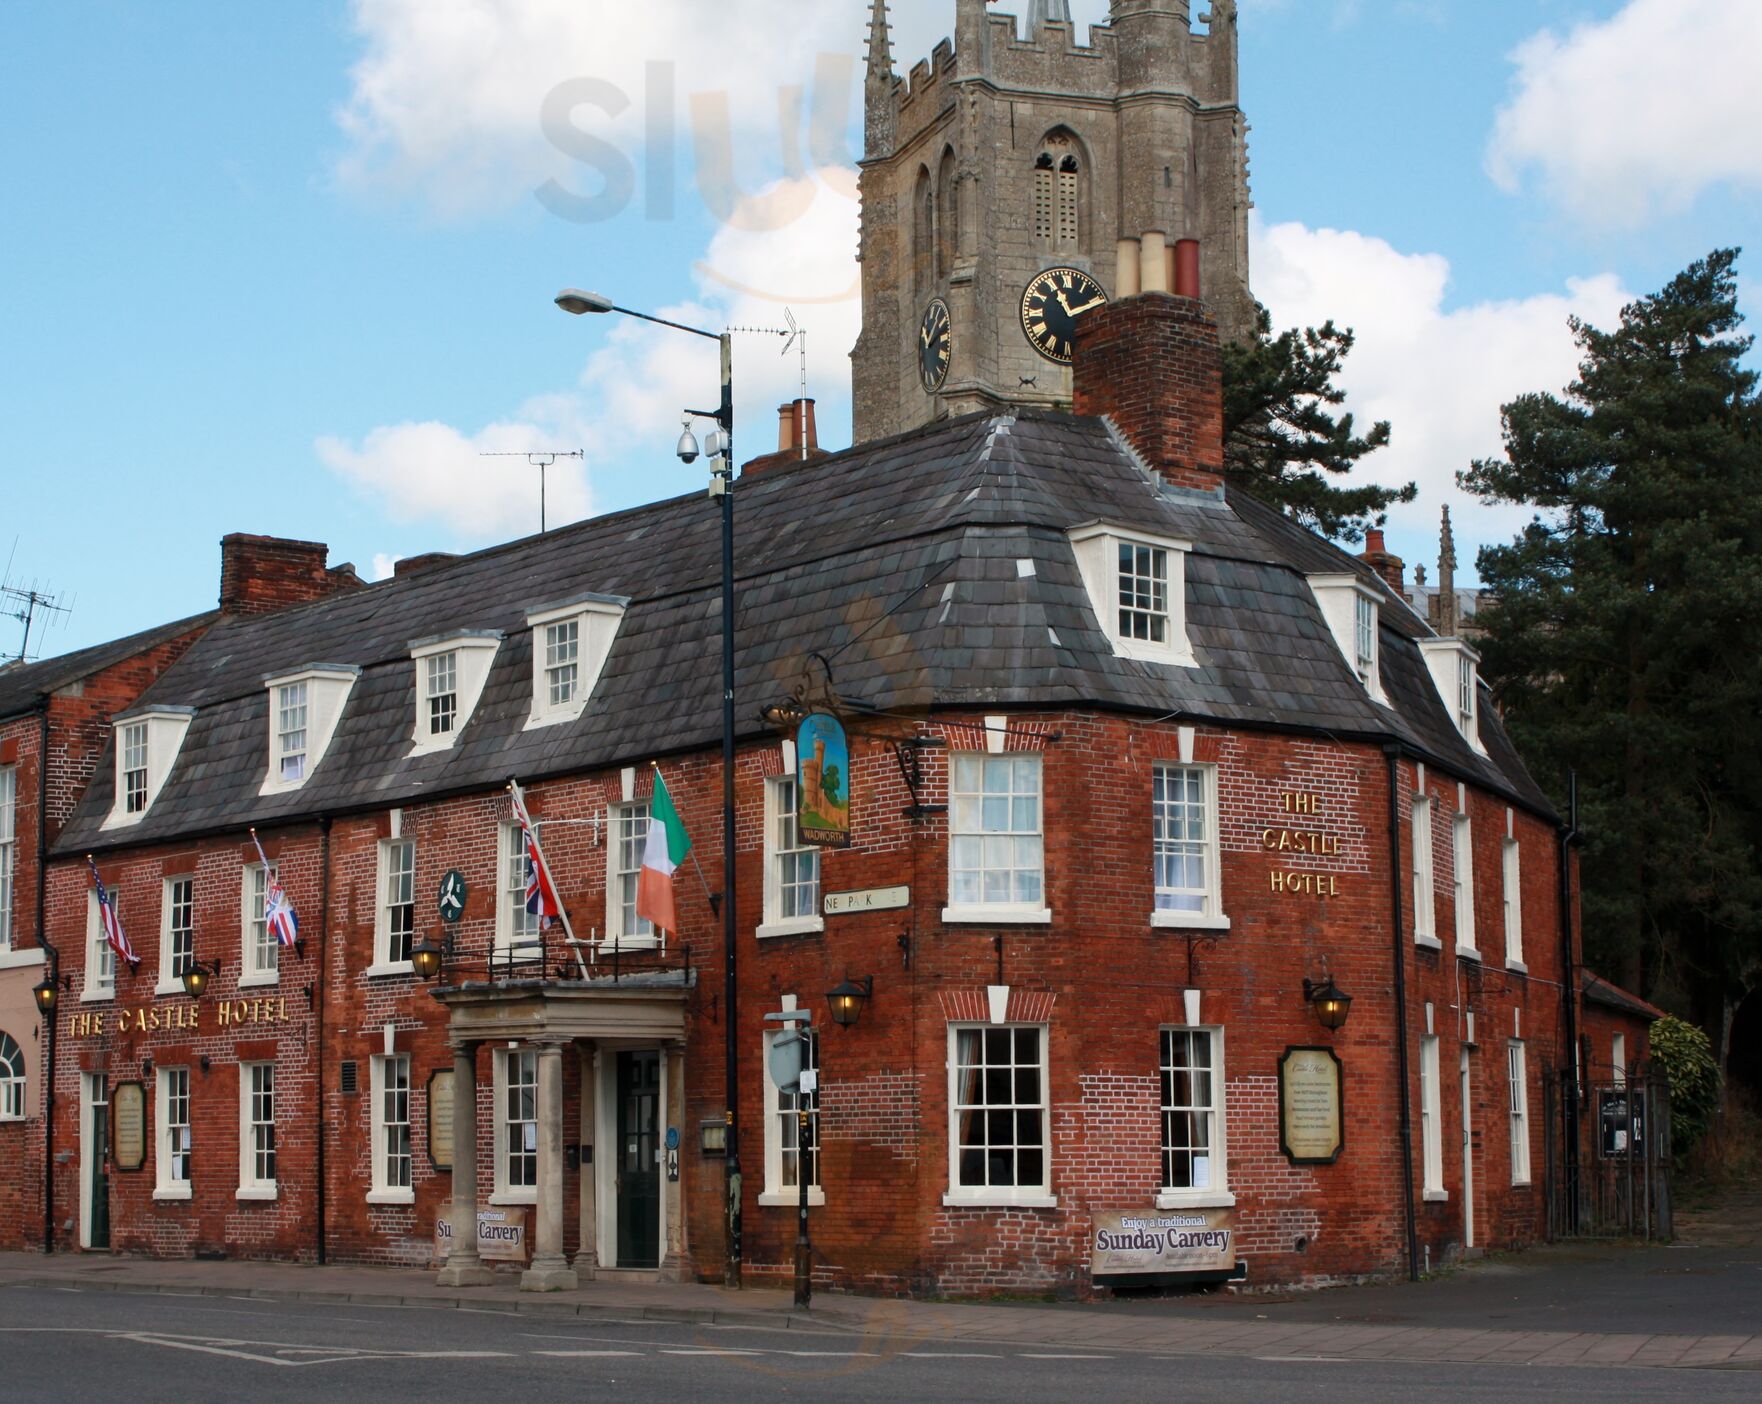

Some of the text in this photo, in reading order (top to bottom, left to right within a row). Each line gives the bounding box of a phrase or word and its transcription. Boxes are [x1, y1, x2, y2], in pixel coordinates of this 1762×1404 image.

[1281, 791, 1322, 814] THE
[803, 829, 844, 842] WADWORTH
[1262, 828, 1343, 856] CASTLE
[1270, 871, 1340, 896] HOTEL
[69, 997, 289, 1037] THE CASTLE HOTEL
[479, 1221, 523, 1246] Carvery
[1121, 1214, 1206, 1230] Enjoy a traditional
[1096, 1228, 1231, 1255] Sunday Carvery
